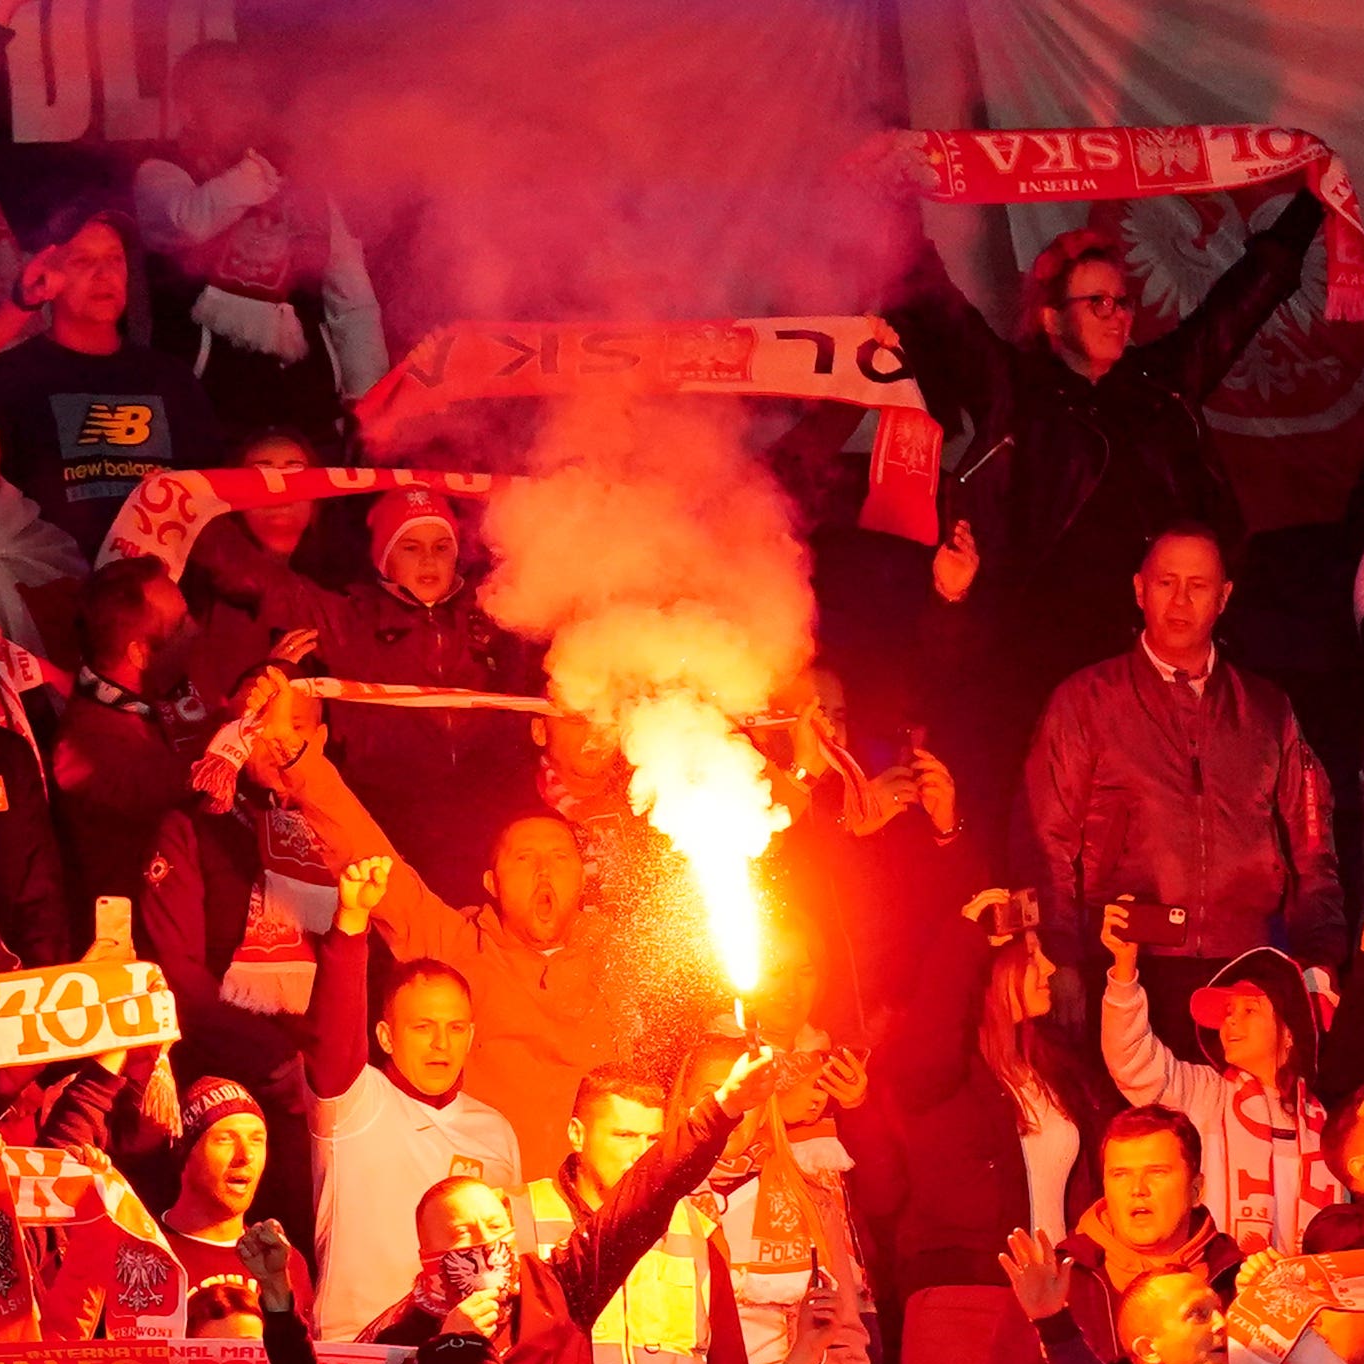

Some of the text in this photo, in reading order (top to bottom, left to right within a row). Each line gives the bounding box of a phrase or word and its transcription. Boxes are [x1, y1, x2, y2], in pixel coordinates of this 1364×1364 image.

[976, 133, 1120, 173] SKA
[775, 331, 915, 385] OL
[220, 1345, 266, 1360] MAT
